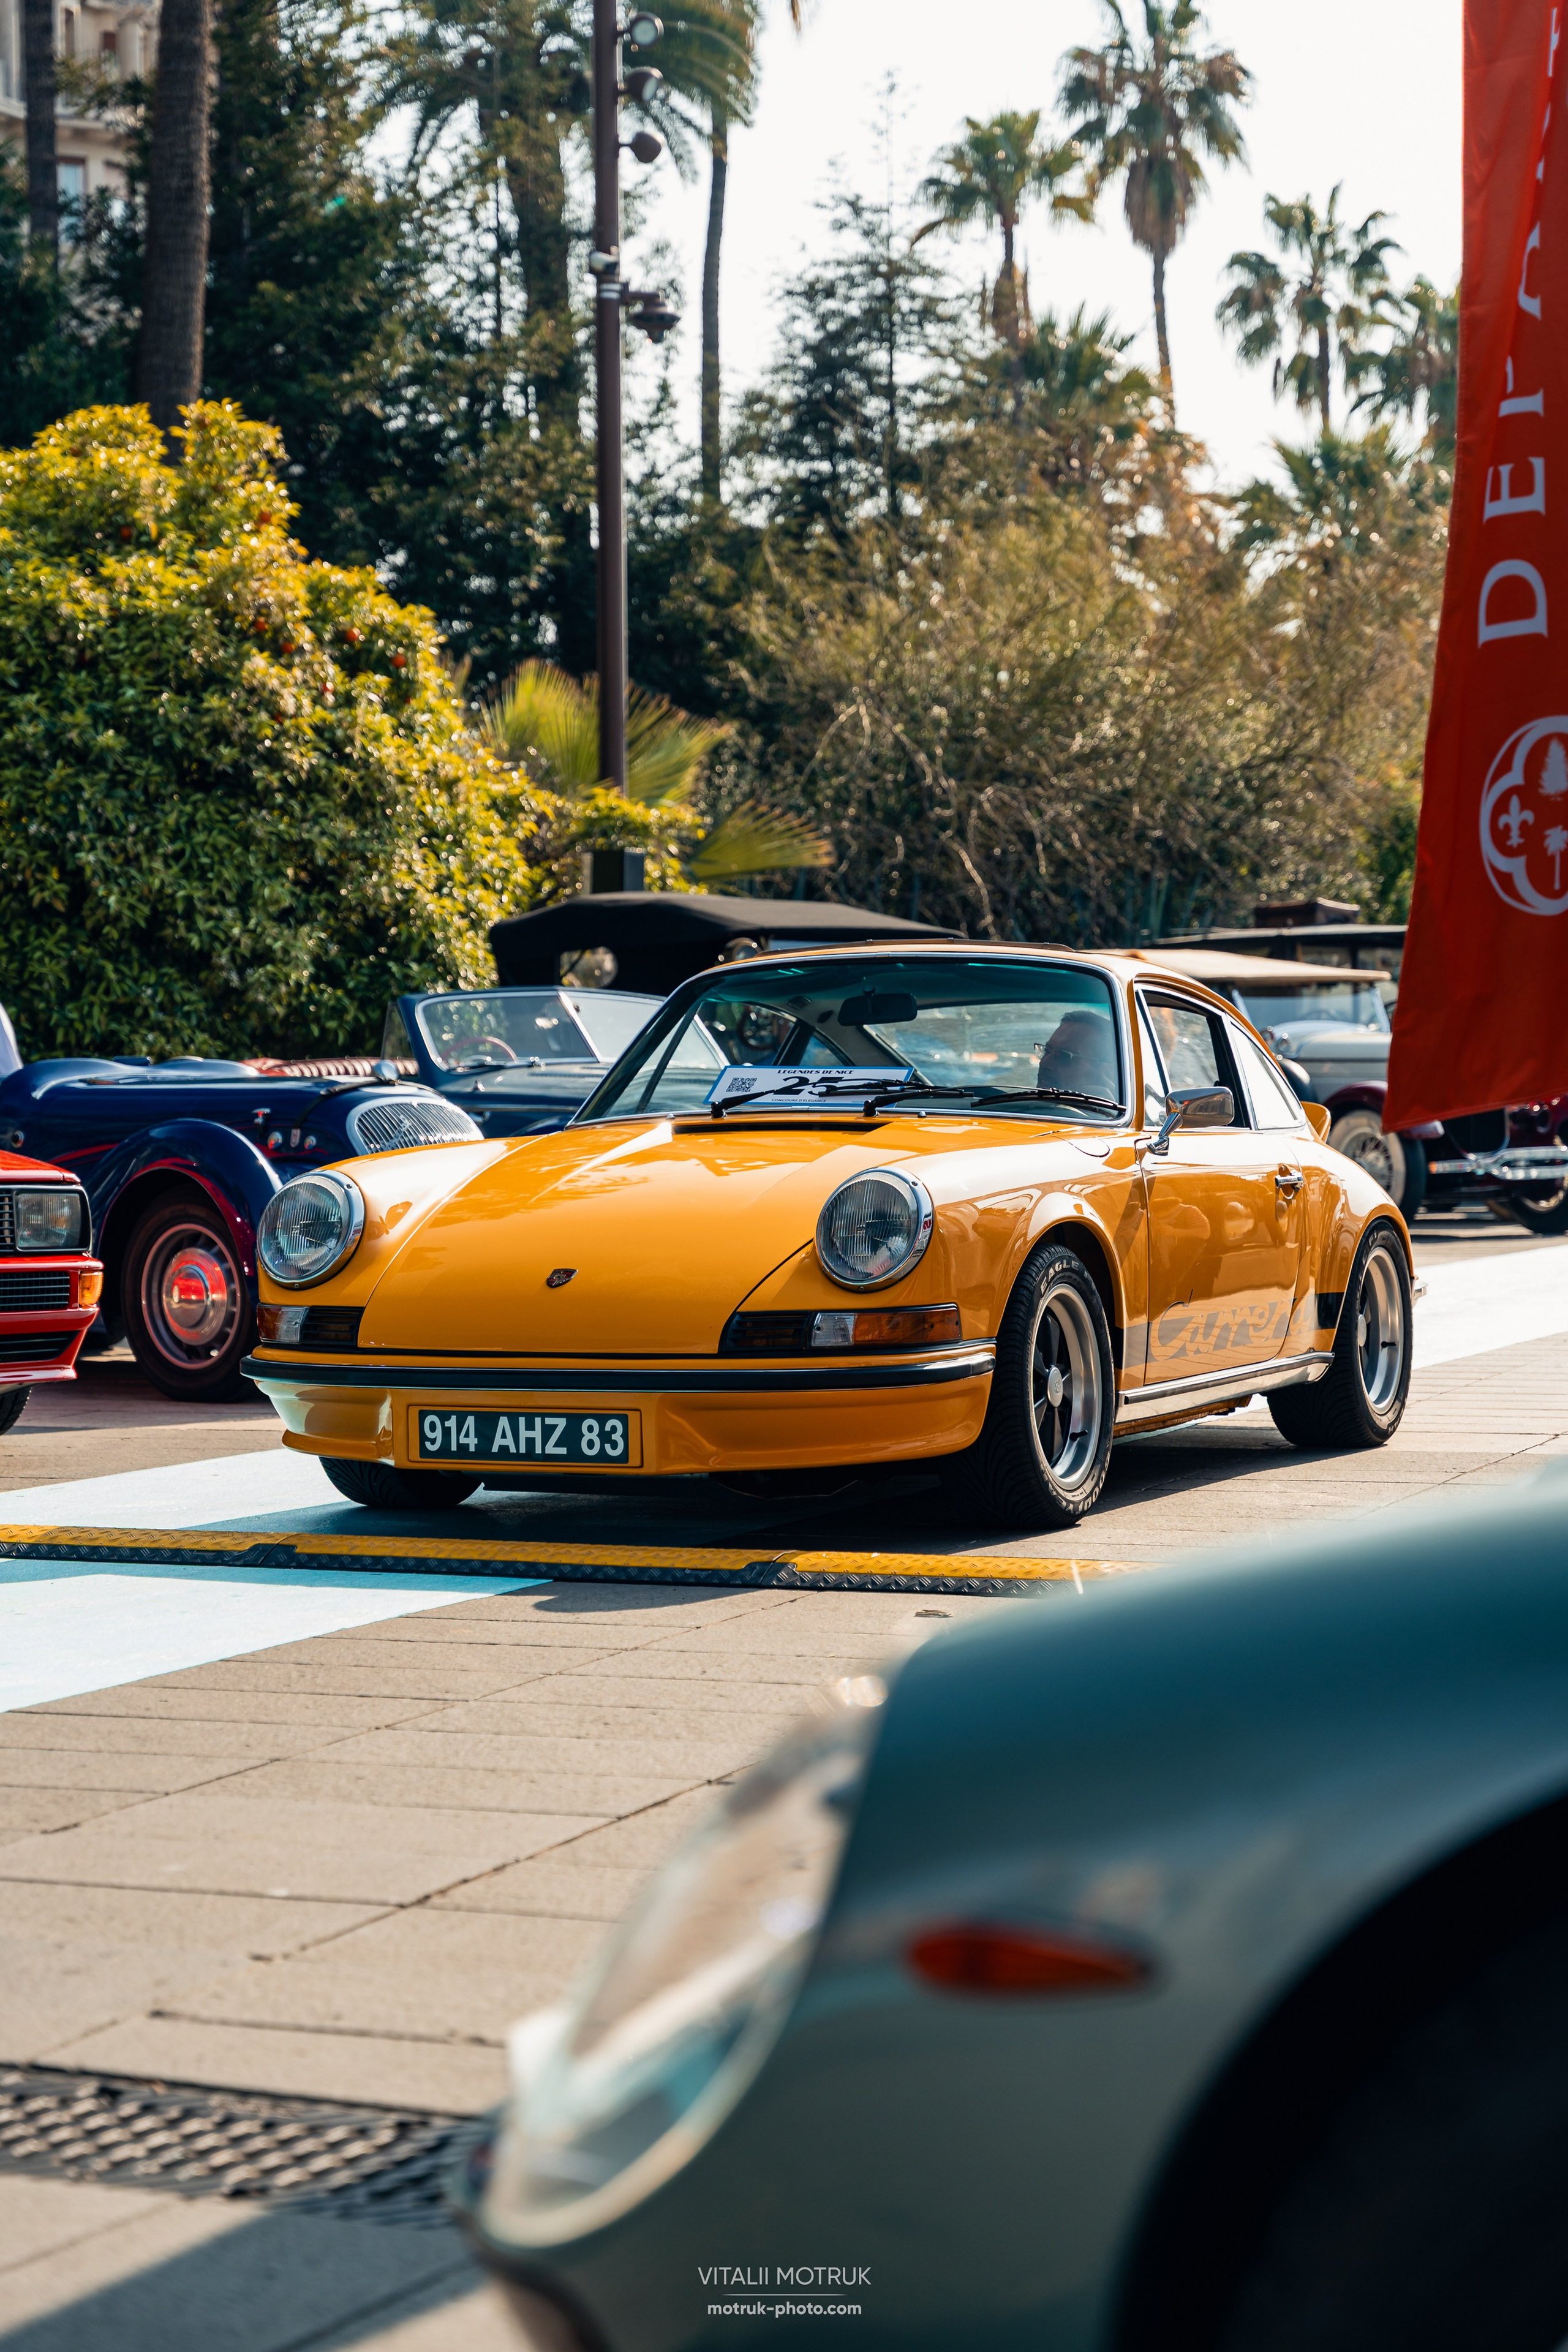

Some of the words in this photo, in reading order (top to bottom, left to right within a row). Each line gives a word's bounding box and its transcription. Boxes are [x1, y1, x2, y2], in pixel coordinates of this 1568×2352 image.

[772, 1076, 845, 1096] 25
[1040, 1259, 1079, 1296] EAGLE
[1150, 1289, 1316, 1361] Carrera
[423, 1414, 478, 1452] 914
[491, 1415, 567, 1455] AHZ
[581, 1419, 624, 1457] 83
[1039, 1450, 1110, 1515] GOODYEAR
